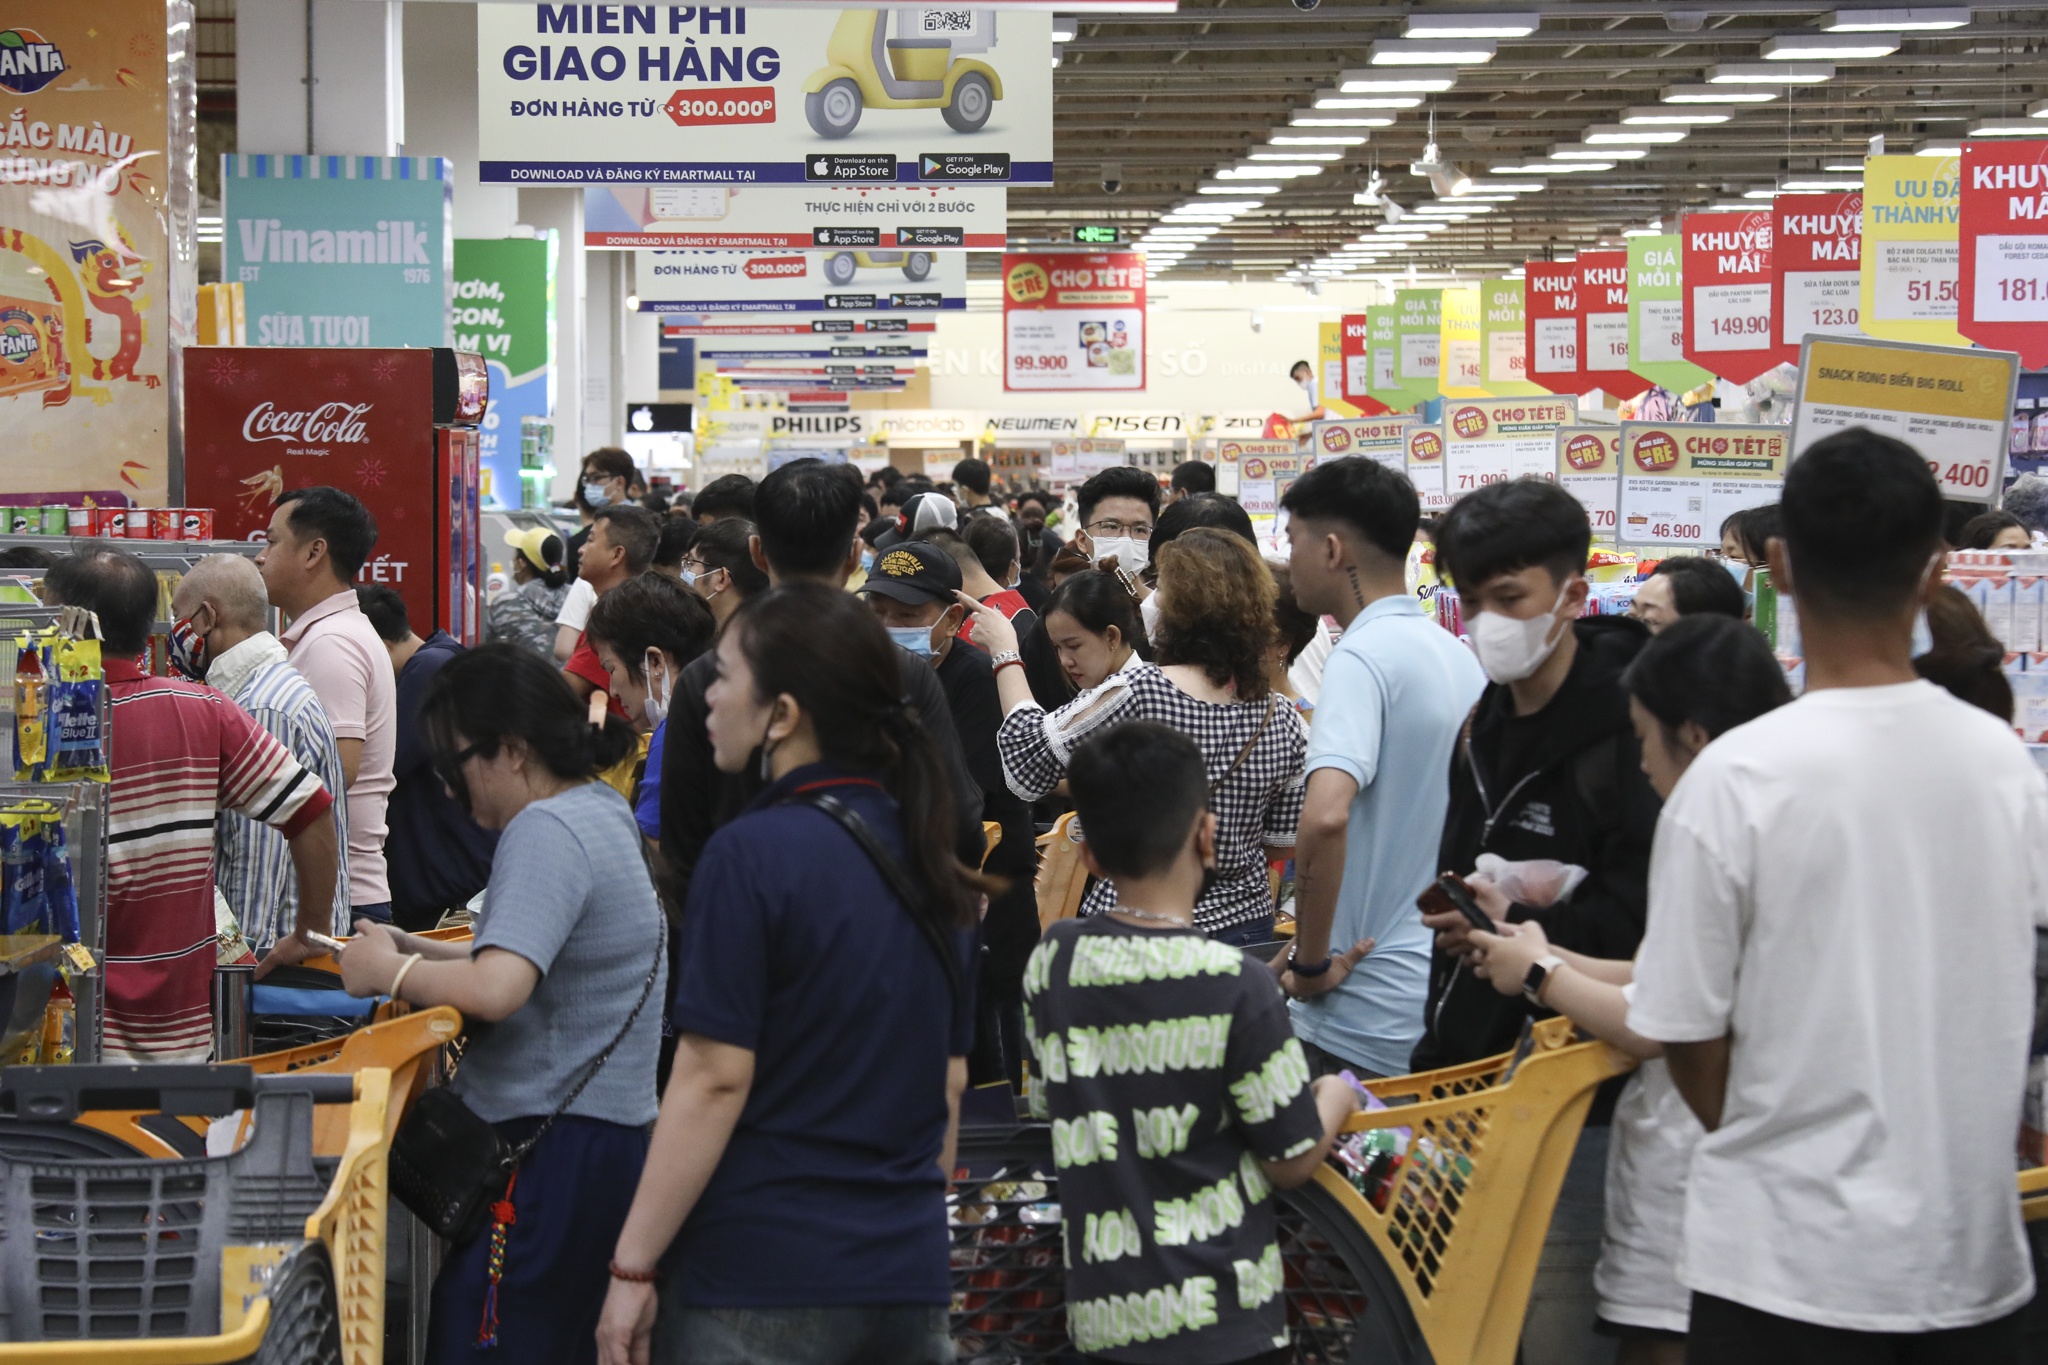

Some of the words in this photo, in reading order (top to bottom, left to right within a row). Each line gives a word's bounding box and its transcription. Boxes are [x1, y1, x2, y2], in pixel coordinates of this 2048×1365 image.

[503, 45, 627, 81] GIAO
[638, 37, 781, 82] HÀNG
[510, 98, 559, 117] ĐƠN
[562, 97, 624, 117] HÀNG
[628, 97, 656, 117] TỪ
[57, 121, 132, 158] MÀU
[511, 169, 584, 180] DOWNLOAD
[586, 167, 604, 180] VÀ
[605, 167, 645, 181] ĐĂNG
[646, 167, 661, 181] KÝ
[663, 169, 735, 181] EMARTMALL
[736, 169, 756, 183] TẠI
[834, 166, 857, 178] App
[859, 166, 889, 176] Store
[946, 165, 982, 177] Google
[983, 165, 1004, 176] Play
[1895, 179, 1927, 198] ƯU
[805, 202, 840, 215] THỰC
[843, 201, 874, 215] HIỆN
[902, 201, 925, 213] VỚI
[928, 203, 936, 213] 2
[938, 201, 975, 213] BƯỚC
[1872, 201, 1943, 224] THÀNH
[237, 219, 430, 264] Vinamilk
[607, 237, 661, 246] DOWNLOAD
[662, 236, 674, 245] VÀ
[677, 236, 704, 246] ĐĂNG
[705, 236, 718, 246] KÝ
[719, 238, 771, 246] EMARTMALL
[773, 238, 787, 248] TẠI
[834, 235, 851, 245] App
[852, 235, 874, 243] Store
[916, 235, 942, 244] Google
[943, 235, 959, 244] Play
[1812, 237, 1858, 260] MÃI
[1644, 249, 1675, 267] GIÁ
[1718, 252, 1760, 274] MÃI
[239, 266, 260, 282] EST
[403, 268, 430, 283] 1976
[654, 265, 681, 275] ĐƠN
[684, 265, 719, 275] HÀNG
[722, 264, 736, 275] TỪ
[1584, 268, 1627, 285] KHU
[1638, 267, 1671, 287] MỖI
[1051, 269, 1093, 288] CHỢ
[1494, 290, 1519, 305] GIÁ
[1998, 278, 2048, 301] 181.
[1405, 298, 1427, 311] GIÁ
[1488, 305, 1516, 322] MỖI
[258, 312, 305, 345] SỮA
[0, 334, 38, 355] FANTA
[487, 333, 511, 356] VỊ
[1550, 345, 1576, 359] 119
[1014, 355, 1067, 370] 99.900
[1818, 367, 1854, 381] SNACK
[1857, 371, 1887, 384] RONG
[1917, 377, 1935, 389] BIG
[1937, 379, 1964, 392] ROLL
[242, 401, 374, 443] Coca-Cola
[882, 414, 964, 431] microlab
[1096, 416, 1180, 431] PISEN
[1492, 408, 1526, 422] CHỢ
[773, 416, 861, 433] PHILIPS
[987, 418, 1077, 430] NEWMEN
[306, 448, 329, 456] Magic
[1686, 437, 1728, 456] CHỢ
[1732, 435, 1766, 455] TẾT
[1652, 524, 1701, 538] 46.900
[358, 554, 408, 582] TẾT
[881, 550, 924, 571] JACKSONVILLE
[62, 728, 86, 739] Blue
